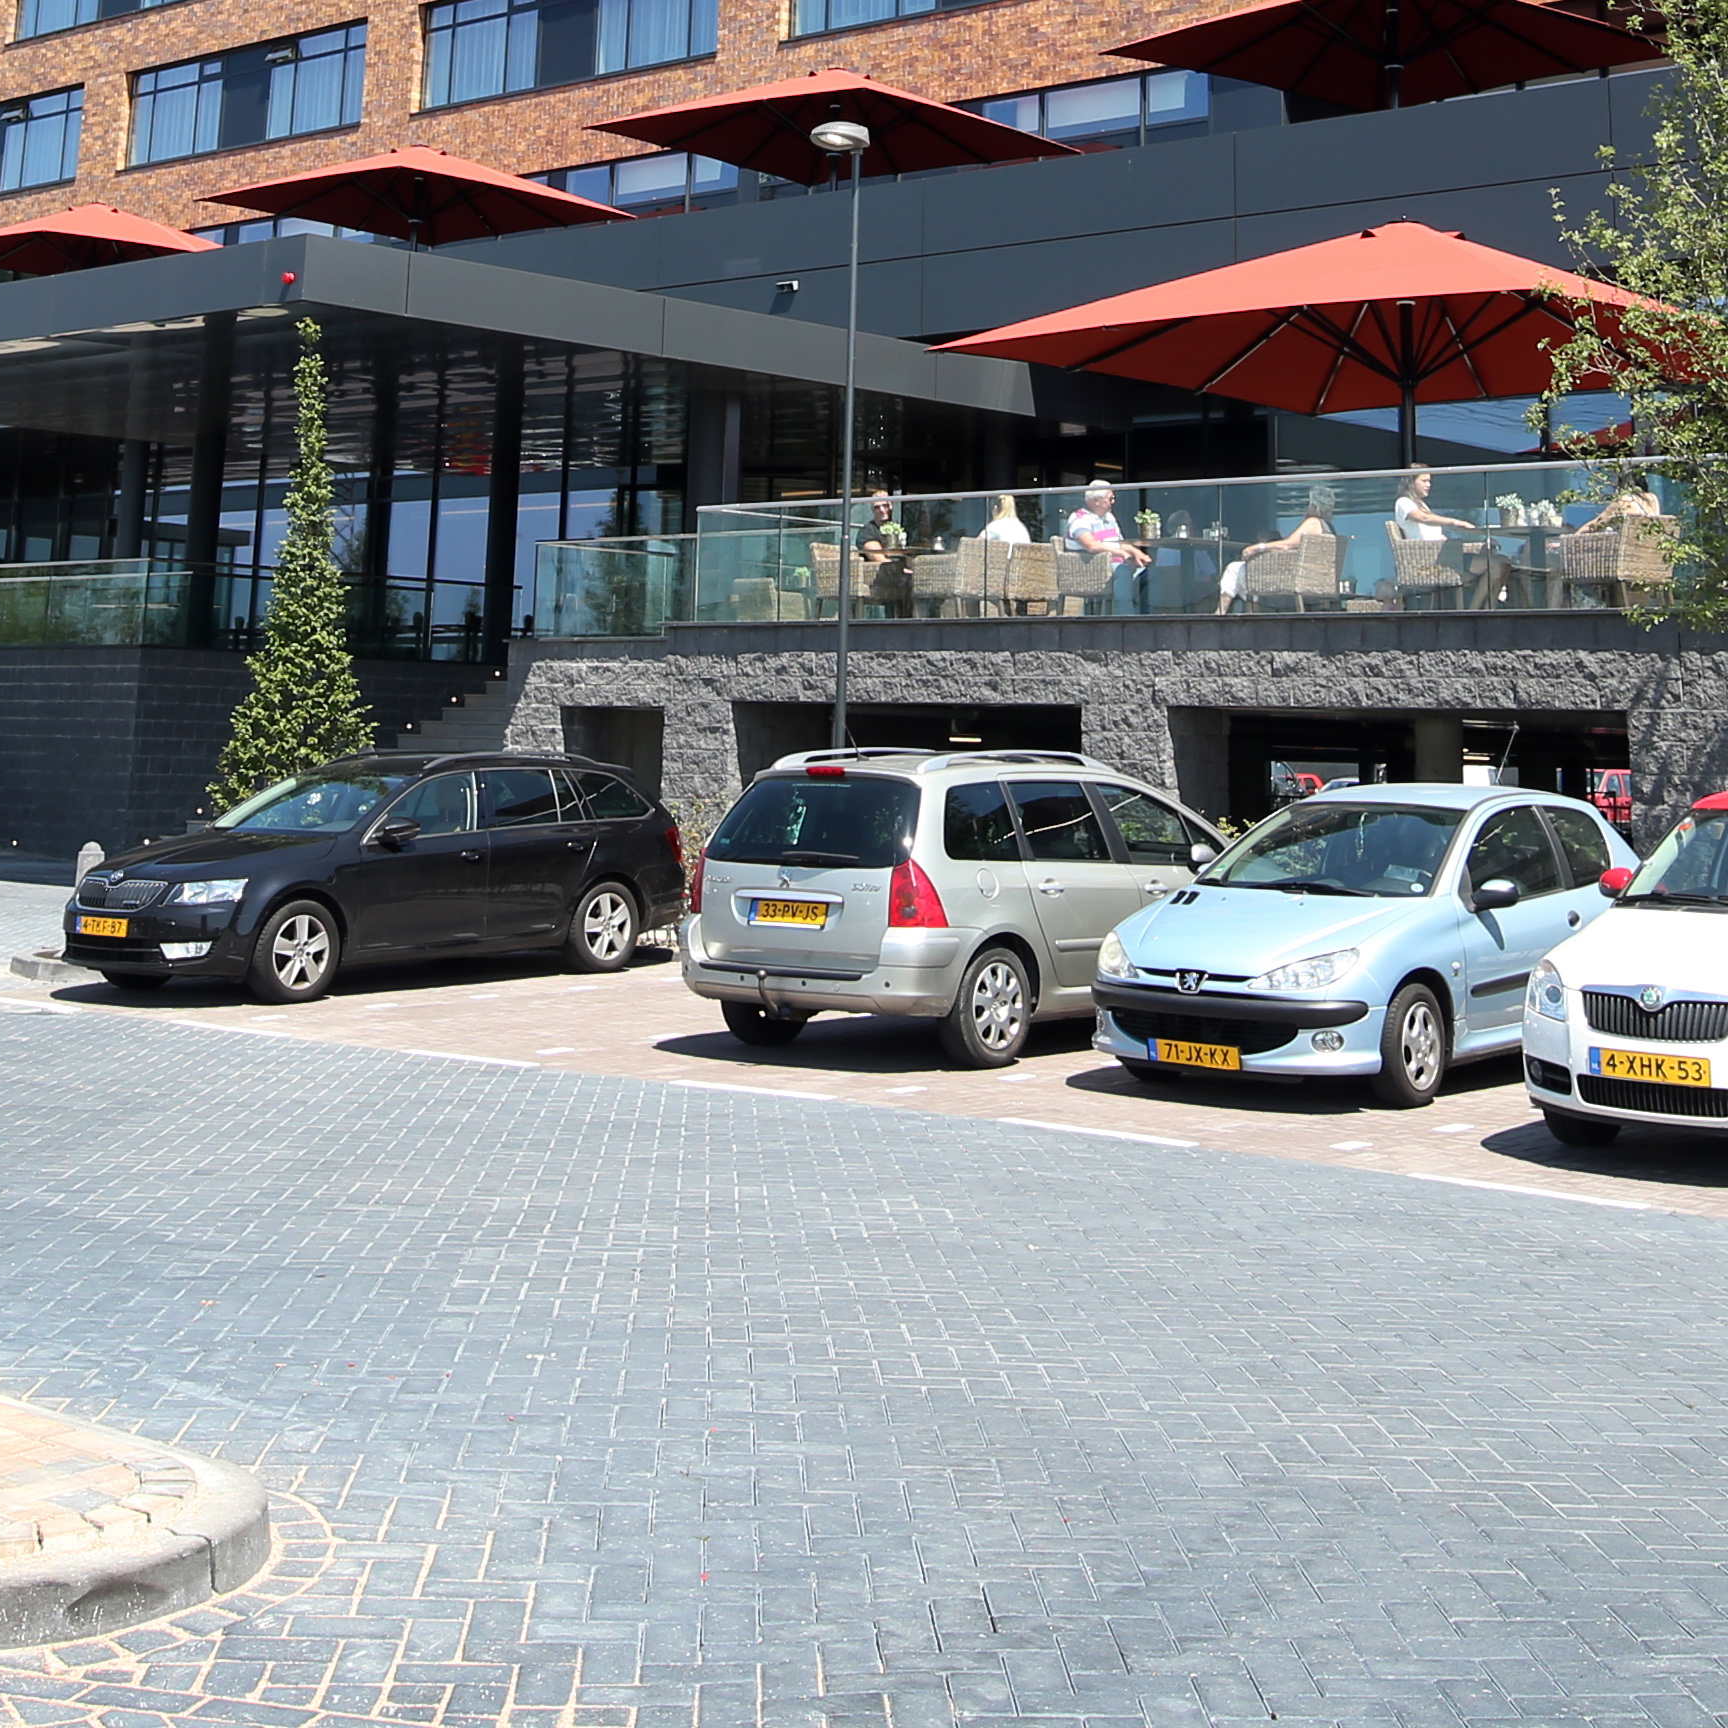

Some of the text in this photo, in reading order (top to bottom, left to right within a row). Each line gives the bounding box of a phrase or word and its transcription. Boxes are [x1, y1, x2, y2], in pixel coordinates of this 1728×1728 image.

[761, 902, 819, 921] 33-PV-JS
[1164, 1042, 1231, 1066] 71-JX-KX
[1605, 1053, 1703, 1082] 4-XHK-53
